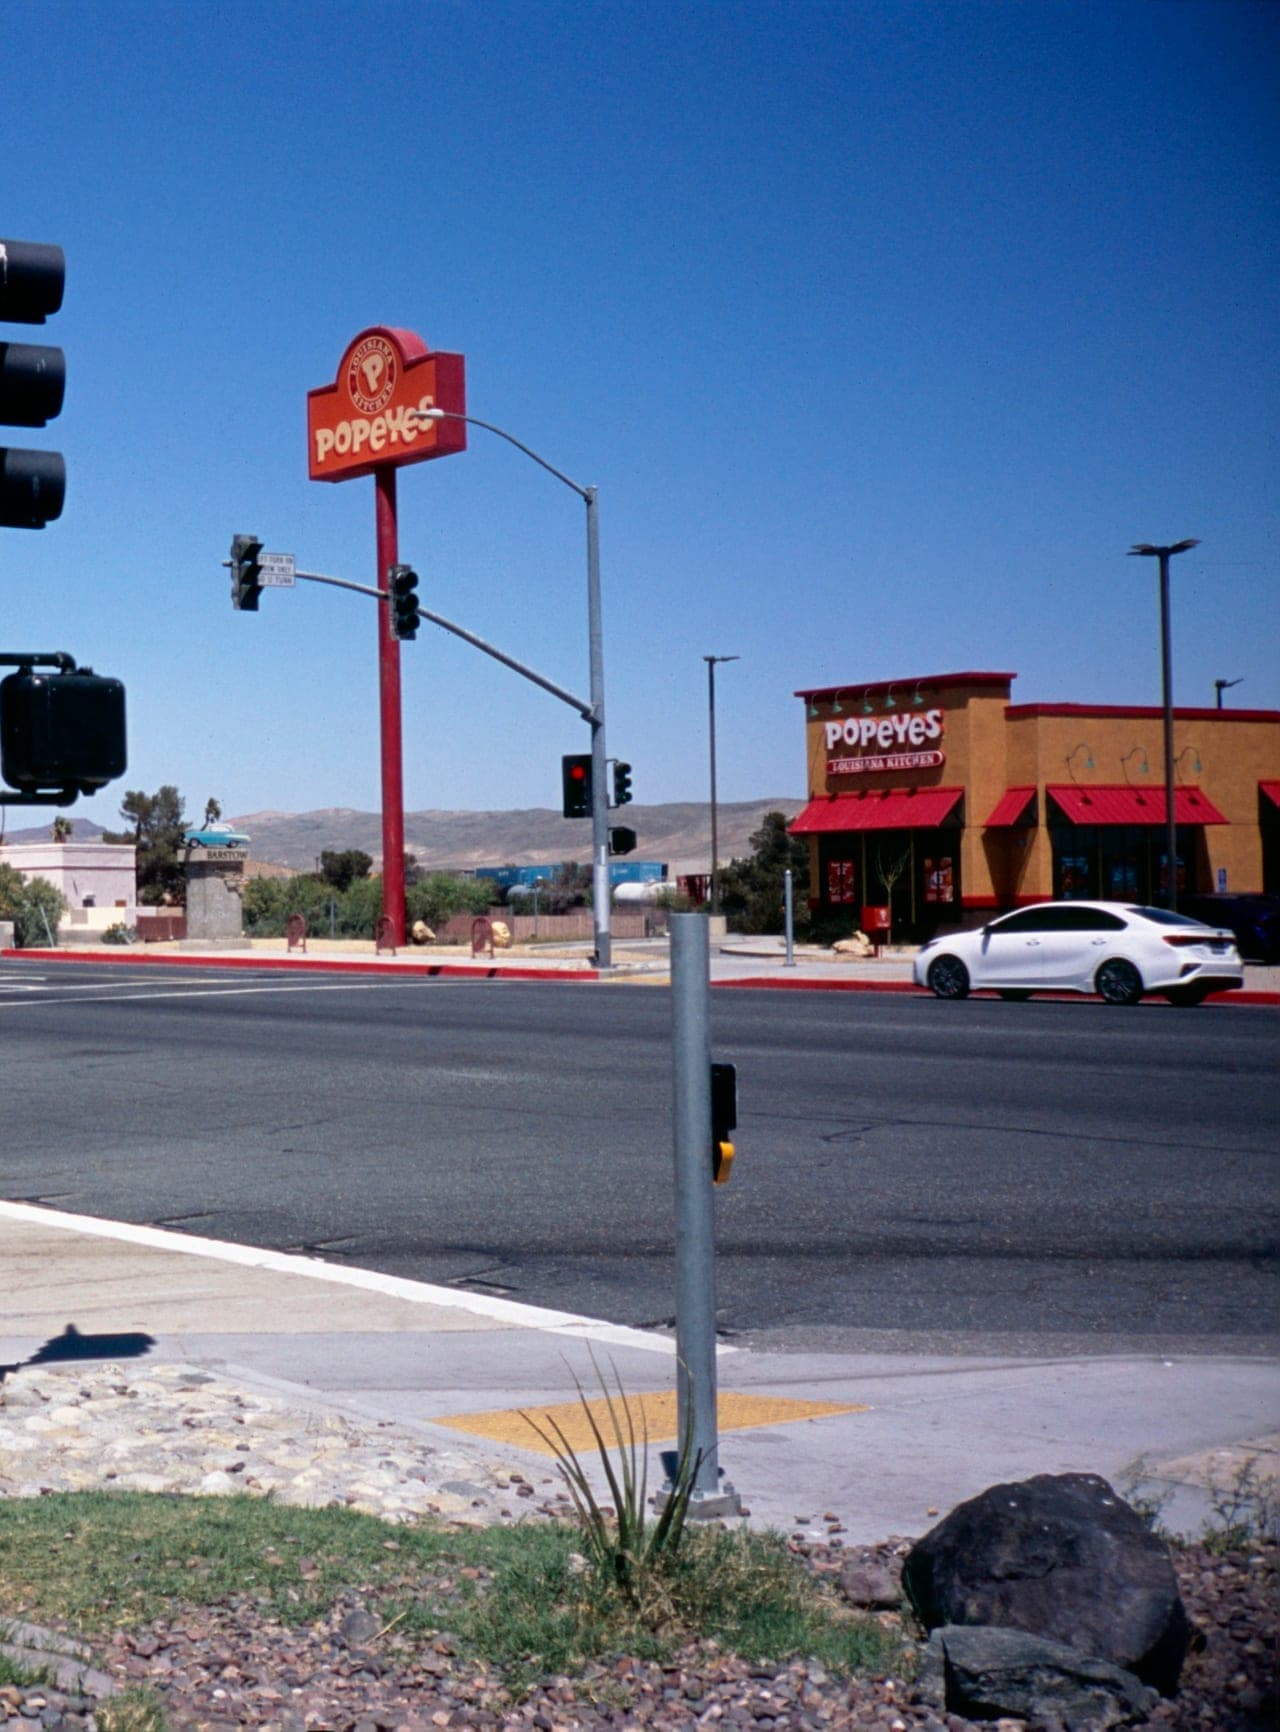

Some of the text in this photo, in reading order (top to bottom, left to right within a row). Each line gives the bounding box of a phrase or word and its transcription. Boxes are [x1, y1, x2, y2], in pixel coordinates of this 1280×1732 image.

[350, 340, 393, 376] LOUISIANA
[362, 354, 384, 393] P
[353, 381, 393, 412] KITCHEN
[832, 754, 934, 772] LOUISIANA KITCHEN
[207, 850, 249, 860] BARSTOW
